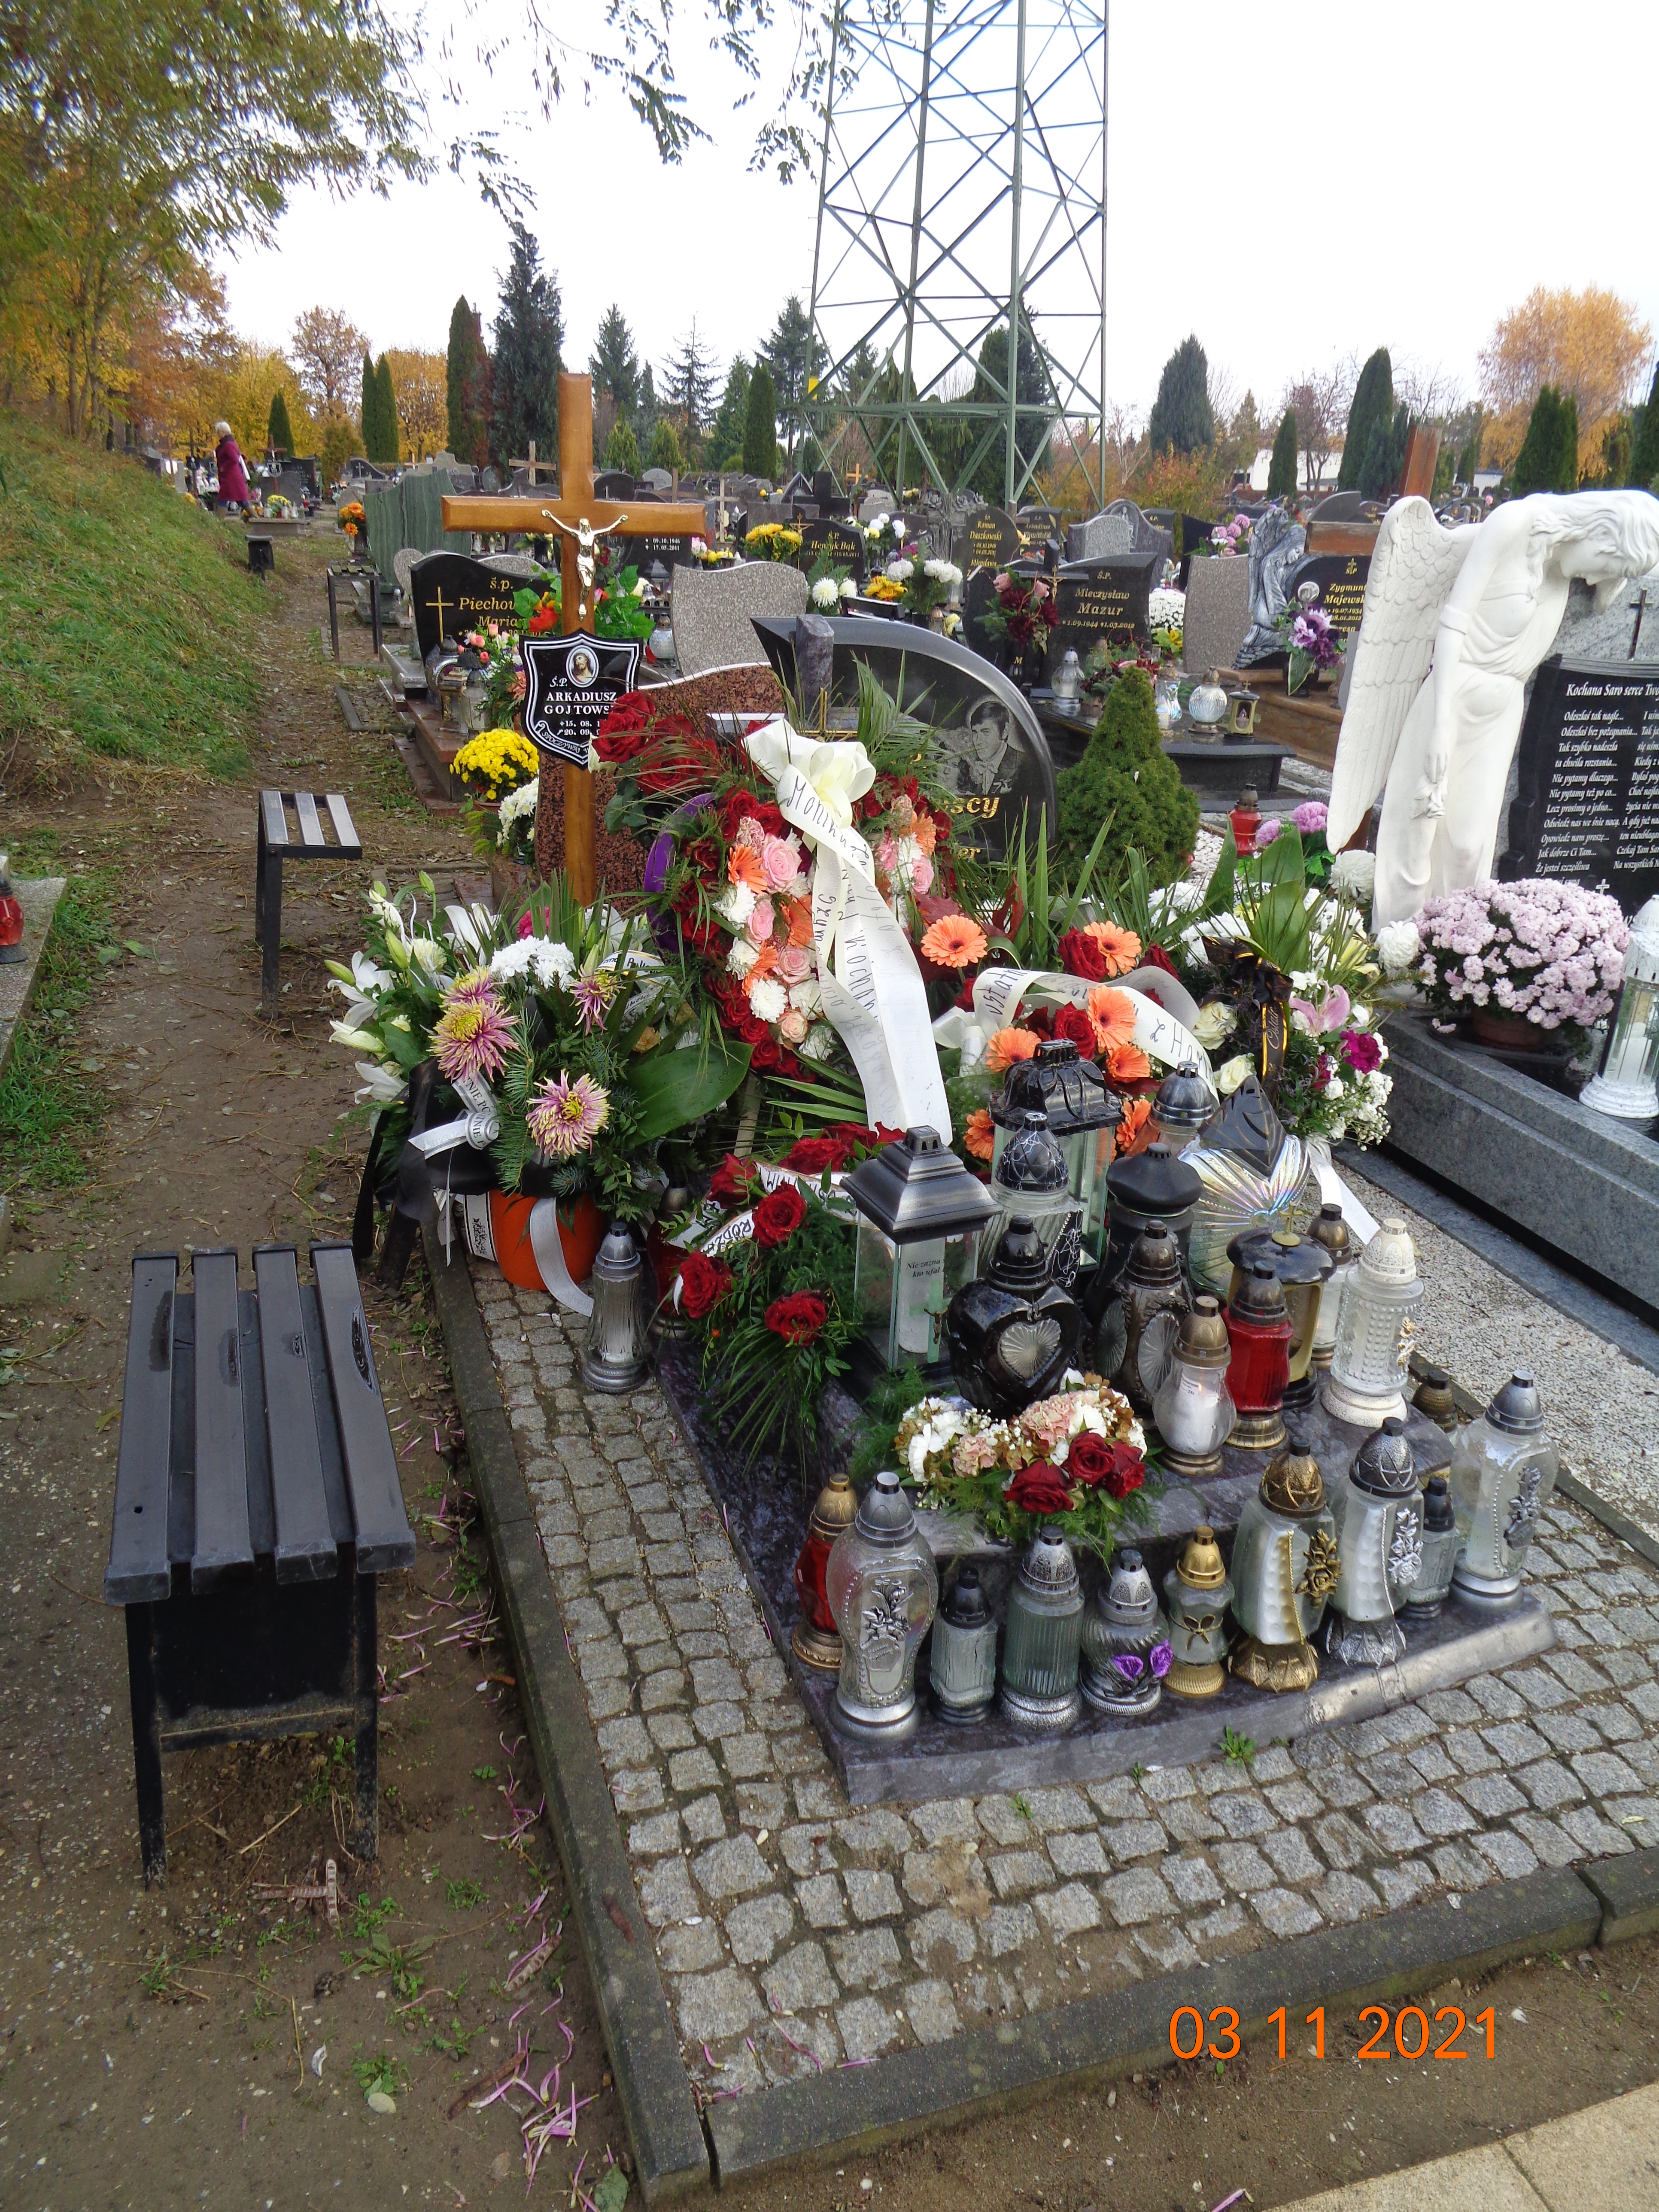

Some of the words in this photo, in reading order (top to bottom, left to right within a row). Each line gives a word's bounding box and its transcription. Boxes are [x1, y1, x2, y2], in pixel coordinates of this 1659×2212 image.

[977, 521, 996, 529] Roman
[969, 530, 1002, 540] Daszkowski
[811, 541, 839, 551] Henyk
[1075, 588, 1130, 600] Mieczysław
[1077, 602, 1124, 616] Mazur
[1566, 681, 1603, 696] Kochana
[1604, 684, 1623, 696] Saro
[1623, 687, 1644, 696] serce
[546, 692, 617, 701] ARKADIUSZ
[1564, 709, 1592, 721] Odeszłaś
[1590, 709, 1603, 720] tak
[1561, 726, 1588, 736] Odeszłaś
[1588, 725, 1599, 736] bez
[1641, 725, 1653, 735] Tak
[542, 731, 580, 754] SPOCZYWAJ
[1559, 741, 1571, 752] Tak
[1571, 741, 1592, 756] szybko
[1637, 742, 1646, 752] się
[1555, 760, 1562, 768] ta
[1563, 757, 1583, 767] chwila
[1635, 755, 1652, 769] Kiedy
[1552, 774, 1563, 783] Nie
[1561, 775, 1588, 786] pytamy
[1549, 789, 1559, 798] Nie
[1558, 790, 1585, 802] pytamy
[1586, 788, 1595, 797] też
[1593, 790, 1604, 800] po
[1546, 804, 1561, 814] Lecz
[1558, 803, 1586, 816] prosimy
[1626, 802, 1641, 814] życia
[1642, 802, 1652, 810] nie
[1592, 817, 1604, 826] śnie
[1622, 817, 1628, 825] A
[1627, 814, 1638, 829] gdy
[1637, 816, 1651, 829] już
[1538, 848, 1550, 859] Jak
[1549, 847, 1569, 857] dobrze
[1616, 844, 1637, 857] Czekaj
[1637, 845, 1649, 854] Tam
[1535, 862, 1543, 873] Że
[1540, 861, 1561, 876] jesteś
[1560, 860, 1591, 872] szczęśliwa
[1613, 860, 1623, 869] Na
[1623, 858, 1655, 872] wszystkich
[921, 1259, 941, 1267] zazna
